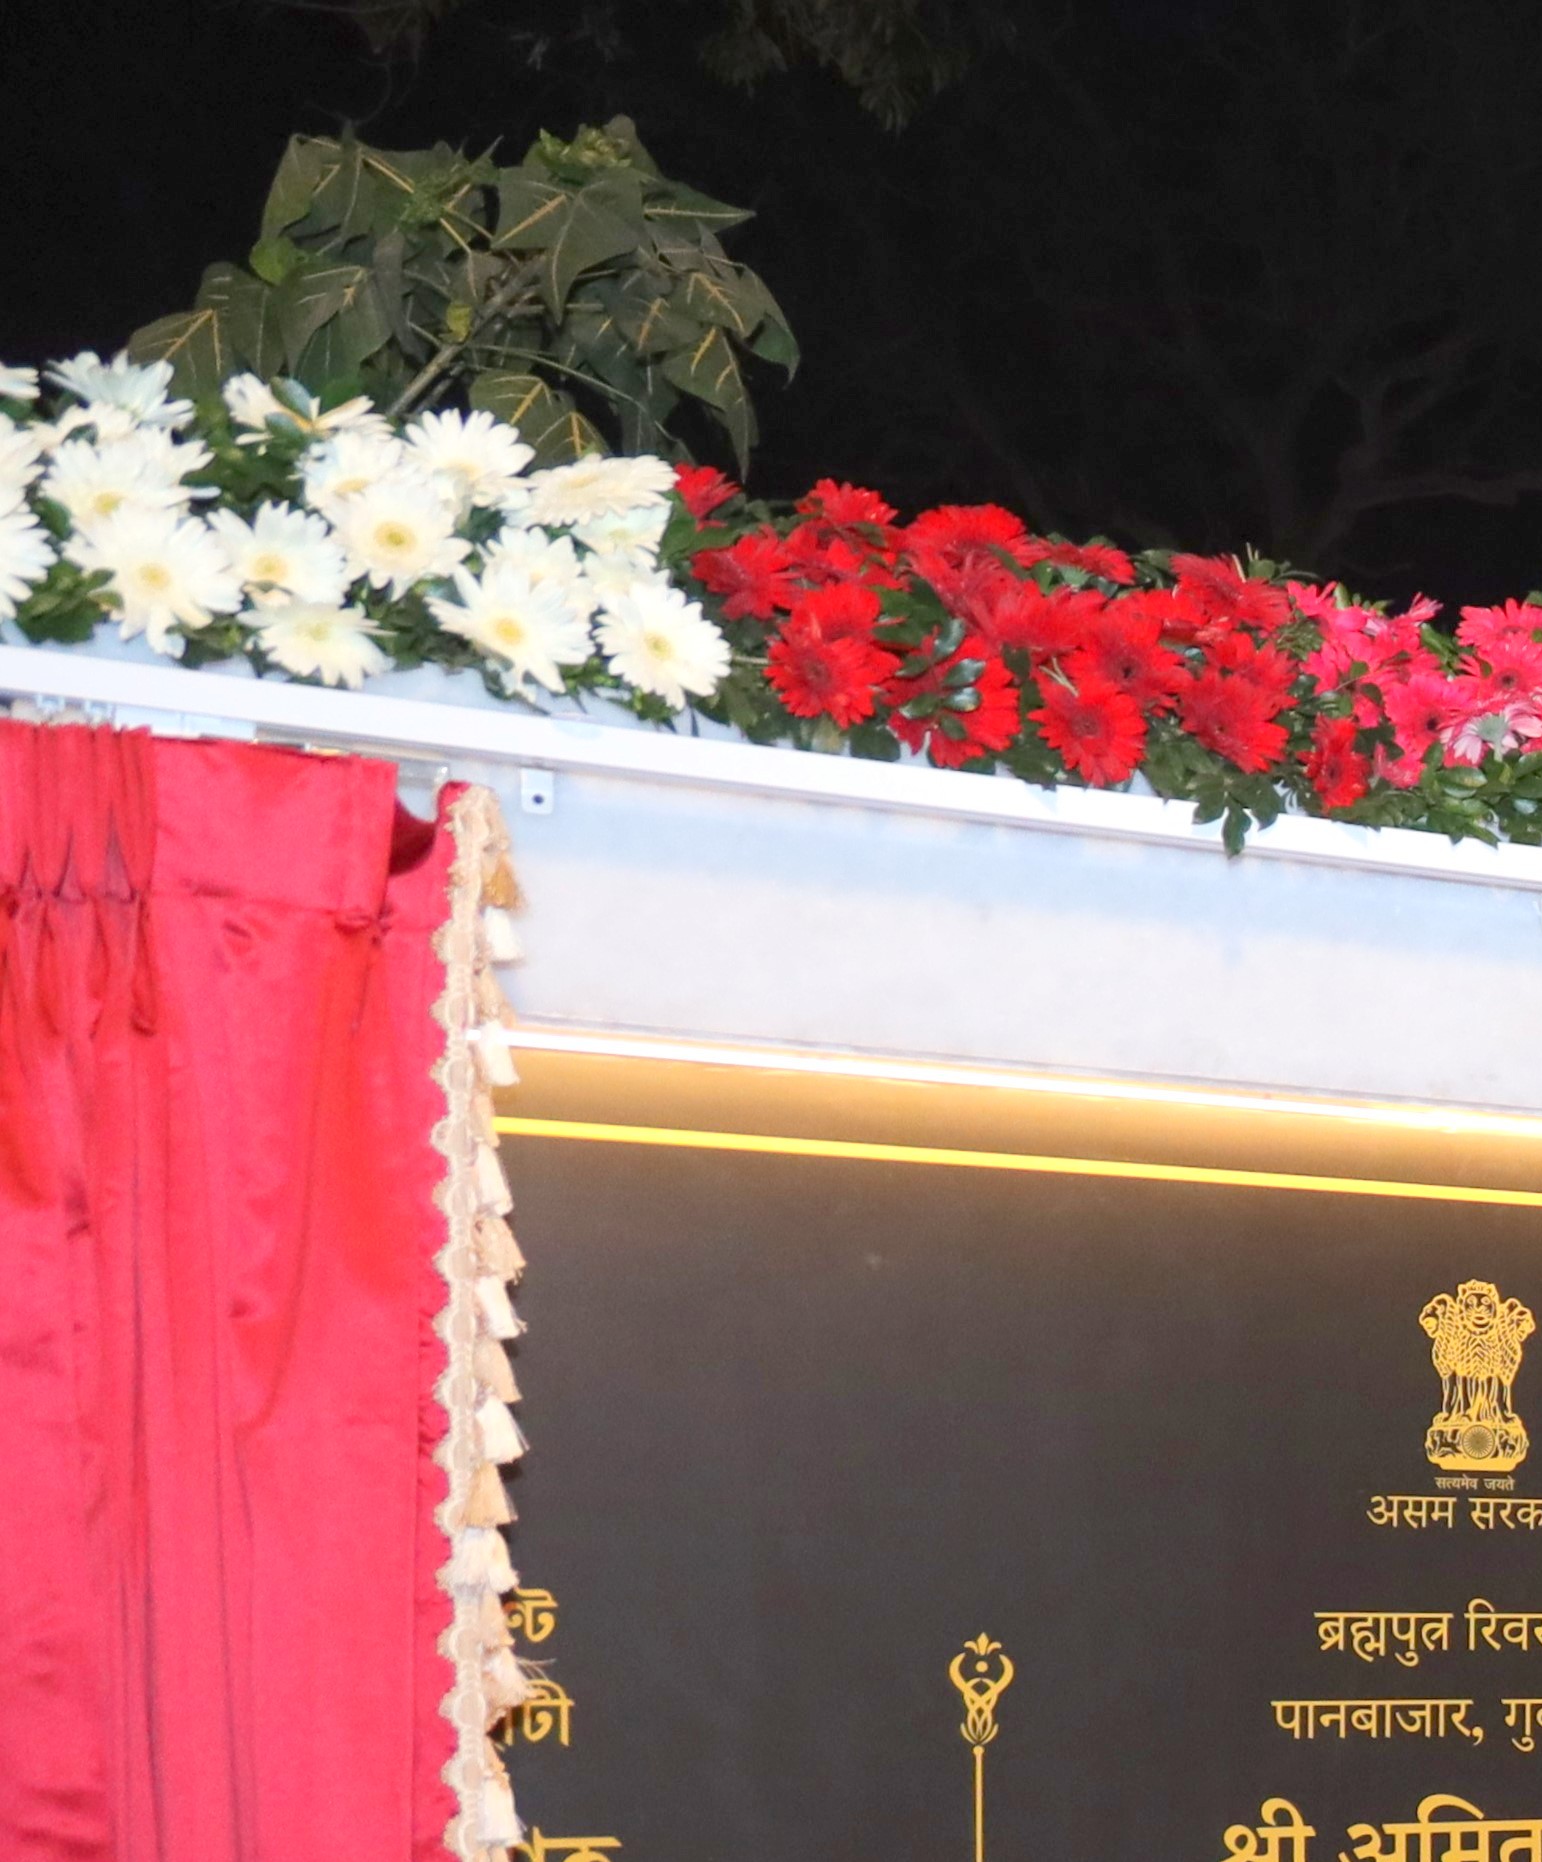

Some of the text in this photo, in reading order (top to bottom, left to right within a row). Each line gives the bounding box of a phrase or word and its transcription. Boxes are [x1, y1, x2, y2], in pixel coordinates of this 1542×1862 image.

[1366, 1494, 1459, 1530] असम
[1313, 1611, 1455, 1668] ब्रह्मपुत्र
[1270, 1698, 1485, 1745] पानबाजार,
